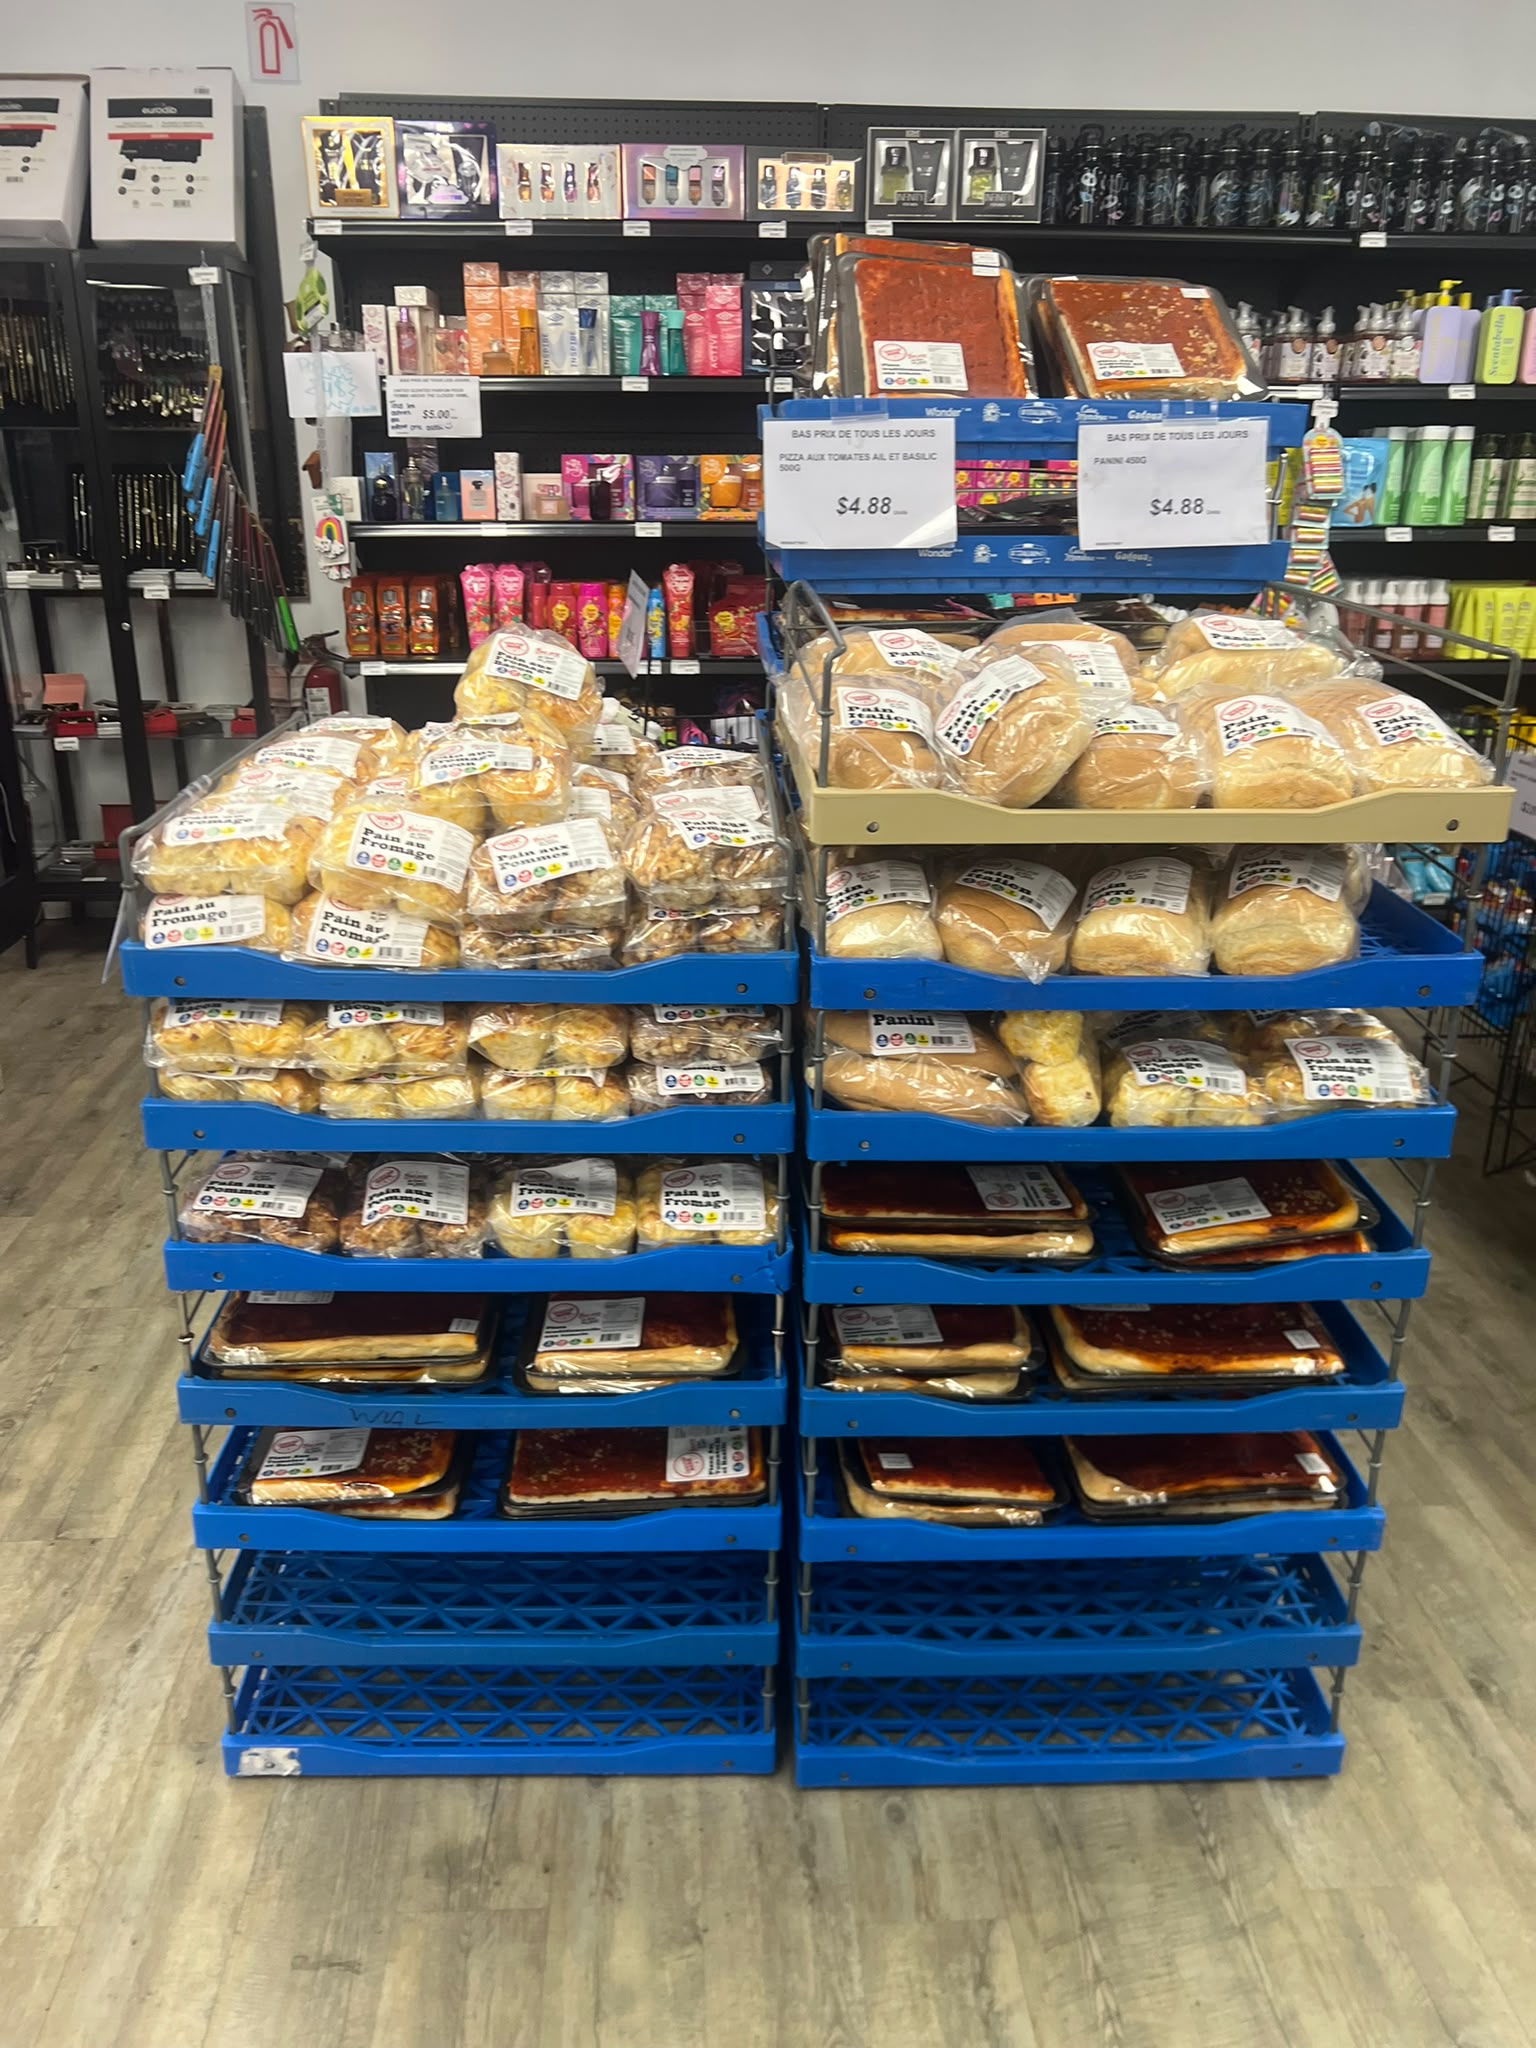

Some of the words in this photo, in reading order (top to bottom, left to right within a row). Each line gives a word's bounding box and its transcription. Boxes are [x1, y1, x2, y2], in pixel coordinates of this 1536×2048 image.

[422, 409, 450, 420] $5.00
[791, 430, 812, 438] BAS
[814, 430, 836, 438] PRIX
[838, 430, 851, 438] DE
[855, 430, 880, 438] TOUS
[883, 430, 900, 438] LES
[903, 430, 936, 438] JOURS
[1107, 433, 1126, 442] BAS
[1129, 432, 1151, 441] PRIX
[1153, 432, 1166, 441] DE
[1169, 432, 1194, 440] TOUS
[1196, 431, 1214, 440] LES
[1217, 430, 1248, 439] JOURS
[779, 453, 803, 461] PIZZA
[807, 453, 825, 461] AUX
[828, 453, 870, 461] TOMATES
[872, 453, 886, 461] AIL
[889, 453, 899, 461] ET
[903, 453, 937, 461] BASILIC
[1093, 457, 1123, 465] PANINI
[1124, 456, 1147, 464] 450G
[779, 464, 801, 472] 500G
[836, 496, 892, 515] $4.88
[1150, 498, 1204, 516] $4.88
[847, 706, 894, 714] Pain
[848, 713, 918, 725] Italien
[1223, 715, 1269, 732] Pain
[1372, 715, 1422, 728] Pain
[362, 827, 400, 843] Pain
[405, 840, 426, 849] au
[360, 837, 436, 861] Fromage
[497, 850, 536, 861] Pain
[540, 844, 571, 854] aux
[498, 851, 570, 870] Pommes
[152, 906, 191, 917] Pain
[194, 902, 216, 910] au
[152, 910, 228, 928] Fromage
[323, 911, 361, 929] Pain
[872, 1014, 935, 1026] Panini
[1307, 1065, 1375, 1076] Fromage
[1311, 1072, 1356, 1082] Bacon
[203, 1186, 270, 1195] Pommes
[368, 1188, 401, 1200] Pain
[404, 1189, 434, 1198] aux
[518, 1187, 586, 1198] Fromage
[664, 1189, 698, 1197] Pain
[367, 1195, 430, 1209] Pommes
[664, 1198, 731, 1209] Fromage
